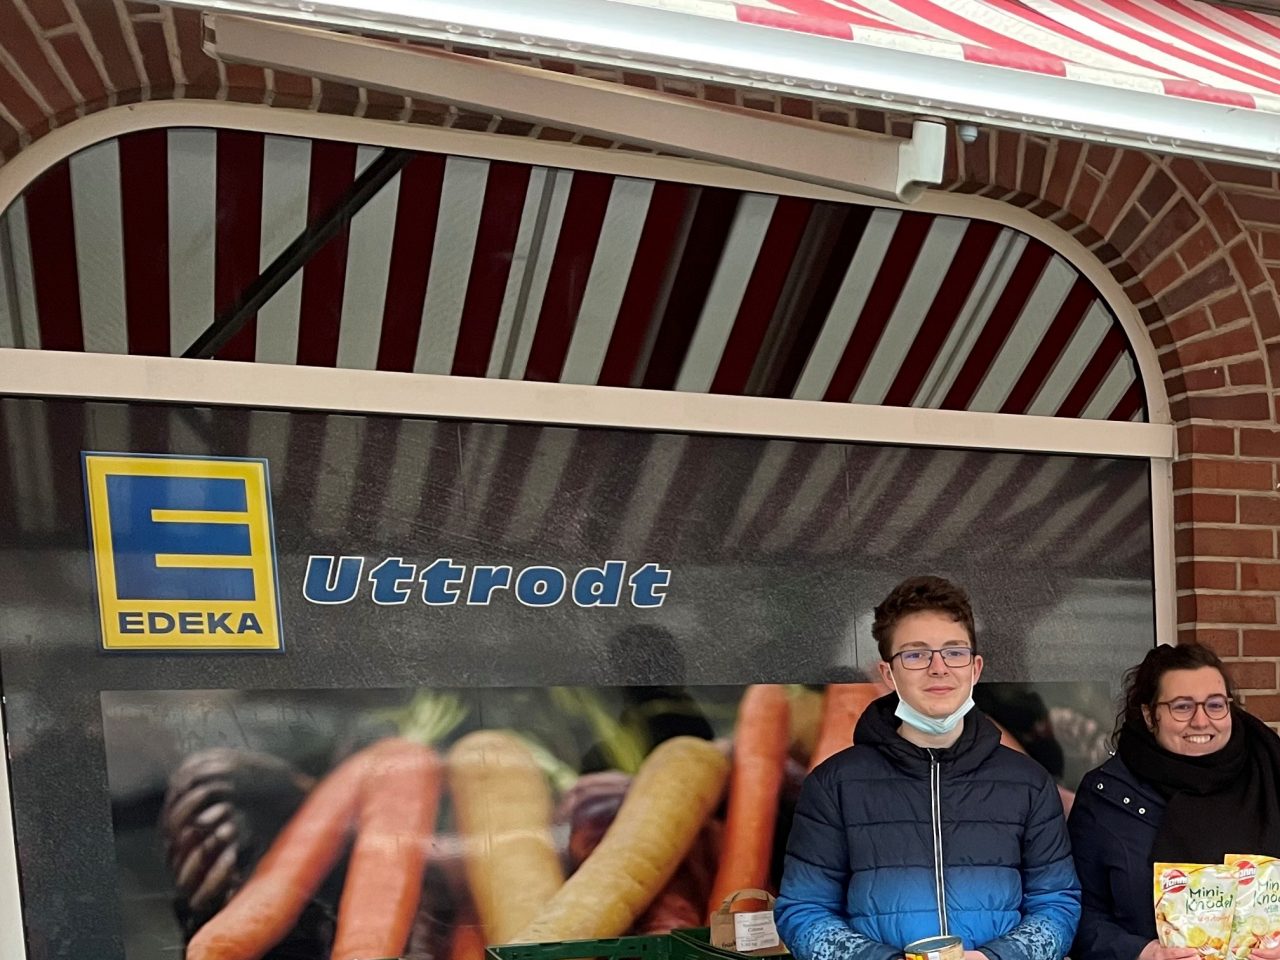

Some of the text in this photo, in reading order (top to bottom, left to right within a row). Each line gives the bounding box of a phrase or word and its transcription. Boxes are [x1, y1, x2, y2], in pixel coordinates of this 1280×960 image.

[302, 555, 671, 608] Uttrodt
[118, 611, 264, 634] EDEKA
[1189, 886, 1224, 898] Mini-
